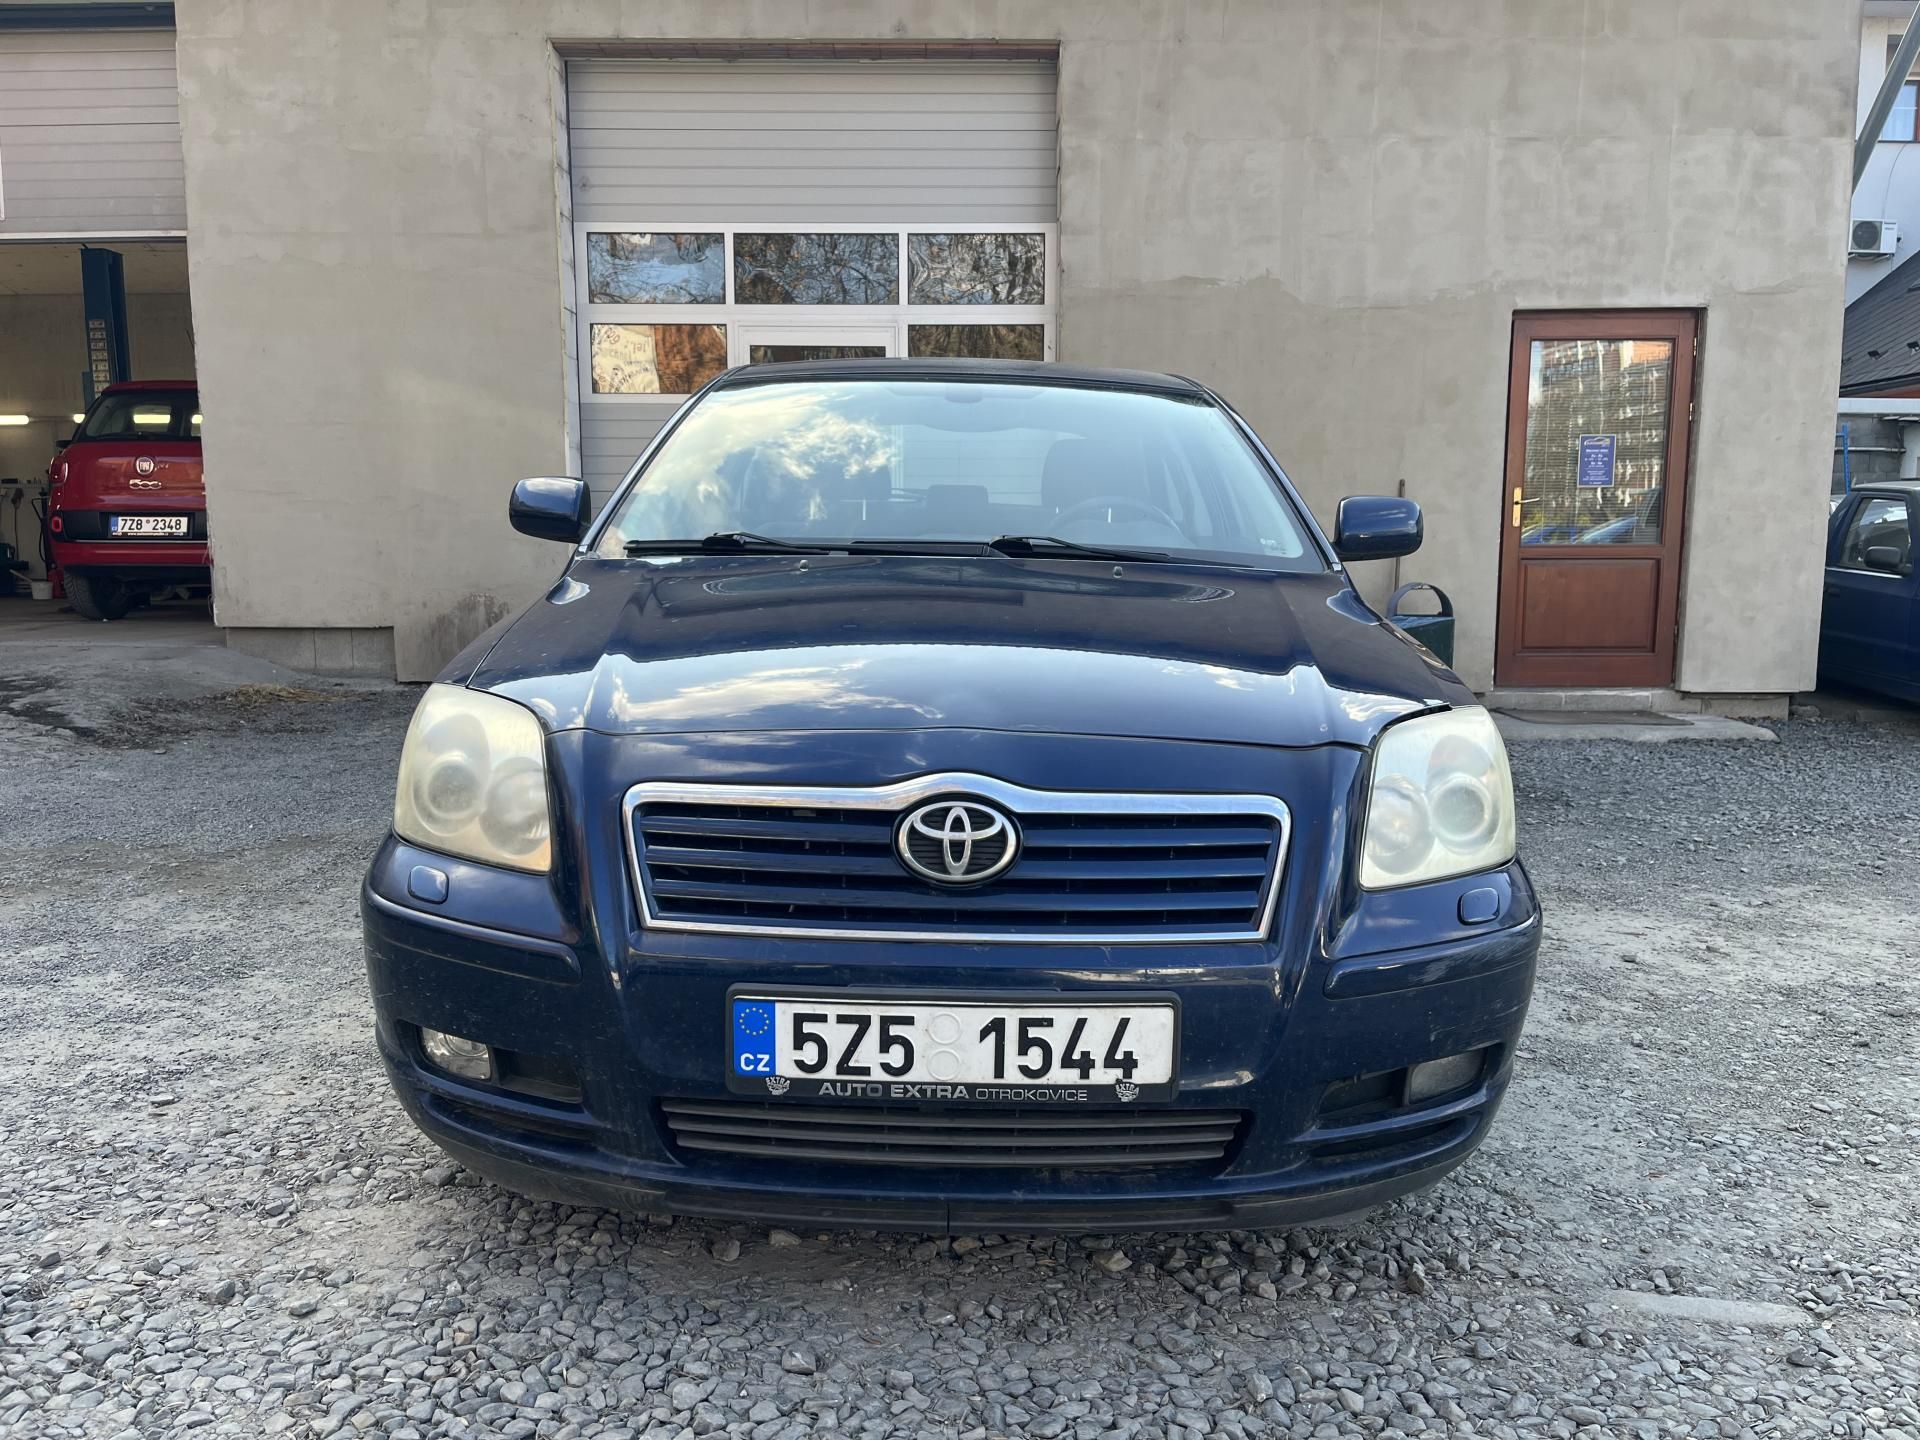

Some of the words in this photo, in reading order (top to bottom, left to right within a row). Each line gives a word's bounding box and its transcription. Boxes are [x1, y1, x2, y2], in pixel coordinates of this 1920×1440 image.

[121, 519, 143, 531] 7Z8
[152, 519, 182, 531] 2348
[793, 1013, 915, 1077] 5Z5
[979, 1017, 1139, 1080] 1544
[740, 1053, 770, 1072] CZ
[765, 1076, 791, 1089] EXTRA
[818, 1082, 883, 1097] AUTO
[890, 1084, 970, 1099] EXTRA
[975, 1088, 1088, 1101] OTROKOVICE
